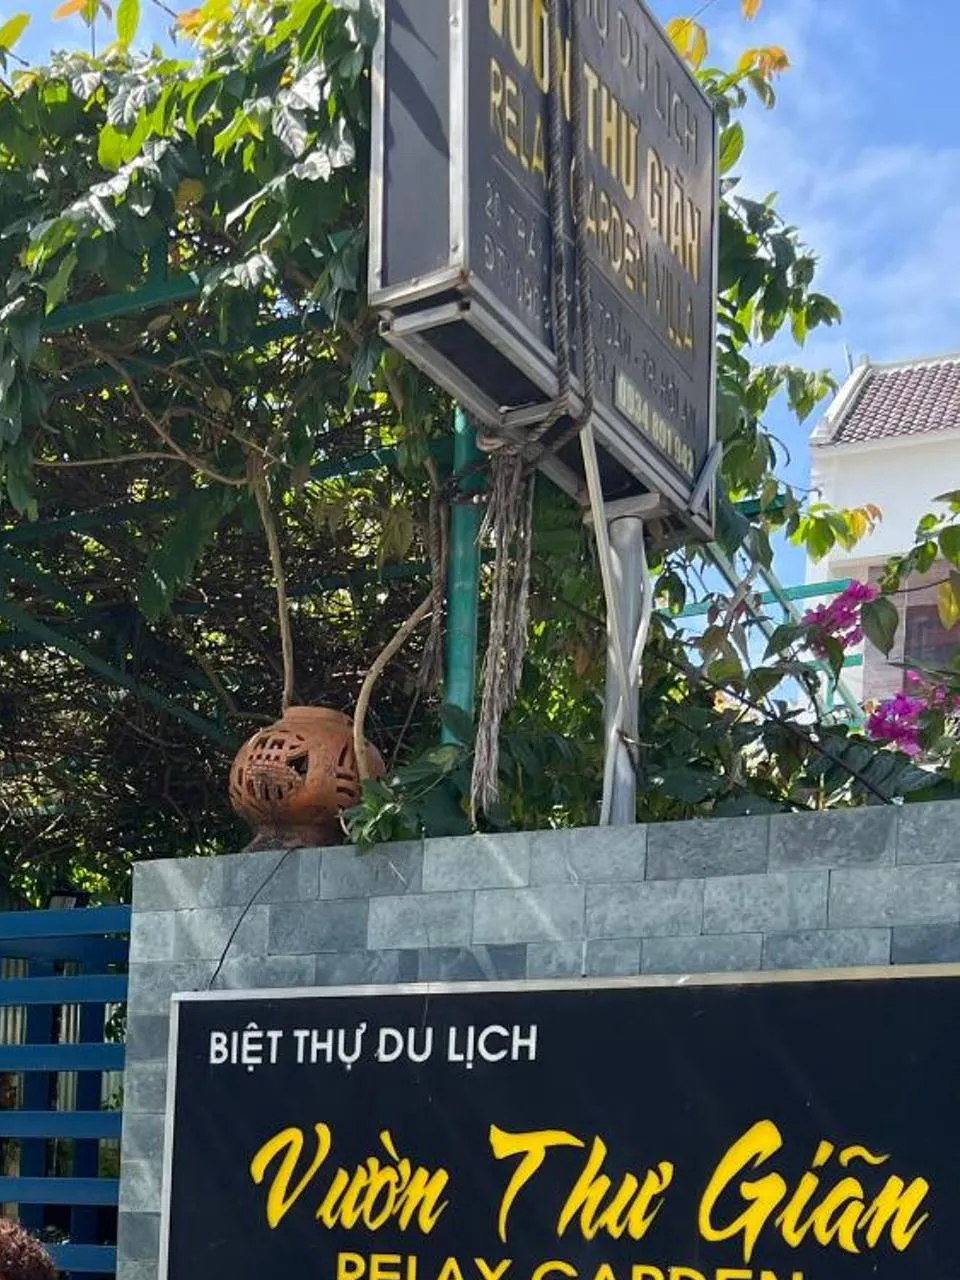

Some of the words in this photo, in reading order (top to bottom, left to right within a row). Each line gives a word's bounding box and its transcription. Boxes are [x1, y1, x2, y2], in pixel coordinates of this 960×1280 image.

[490, 56, 552, 191] RELA
[209, 1022, 283, 1072] BIỆT
[293, 1022, 367, 1071] THỰ
[378, 1026, 433, 1063] DU
[447, 1024, 538, 1069] LỊCH
[249, 1122, 450, 1236] Vườn
[489, 1123, 674, 1243] Thư
[698, 1119, 930, 1264] Giãn
